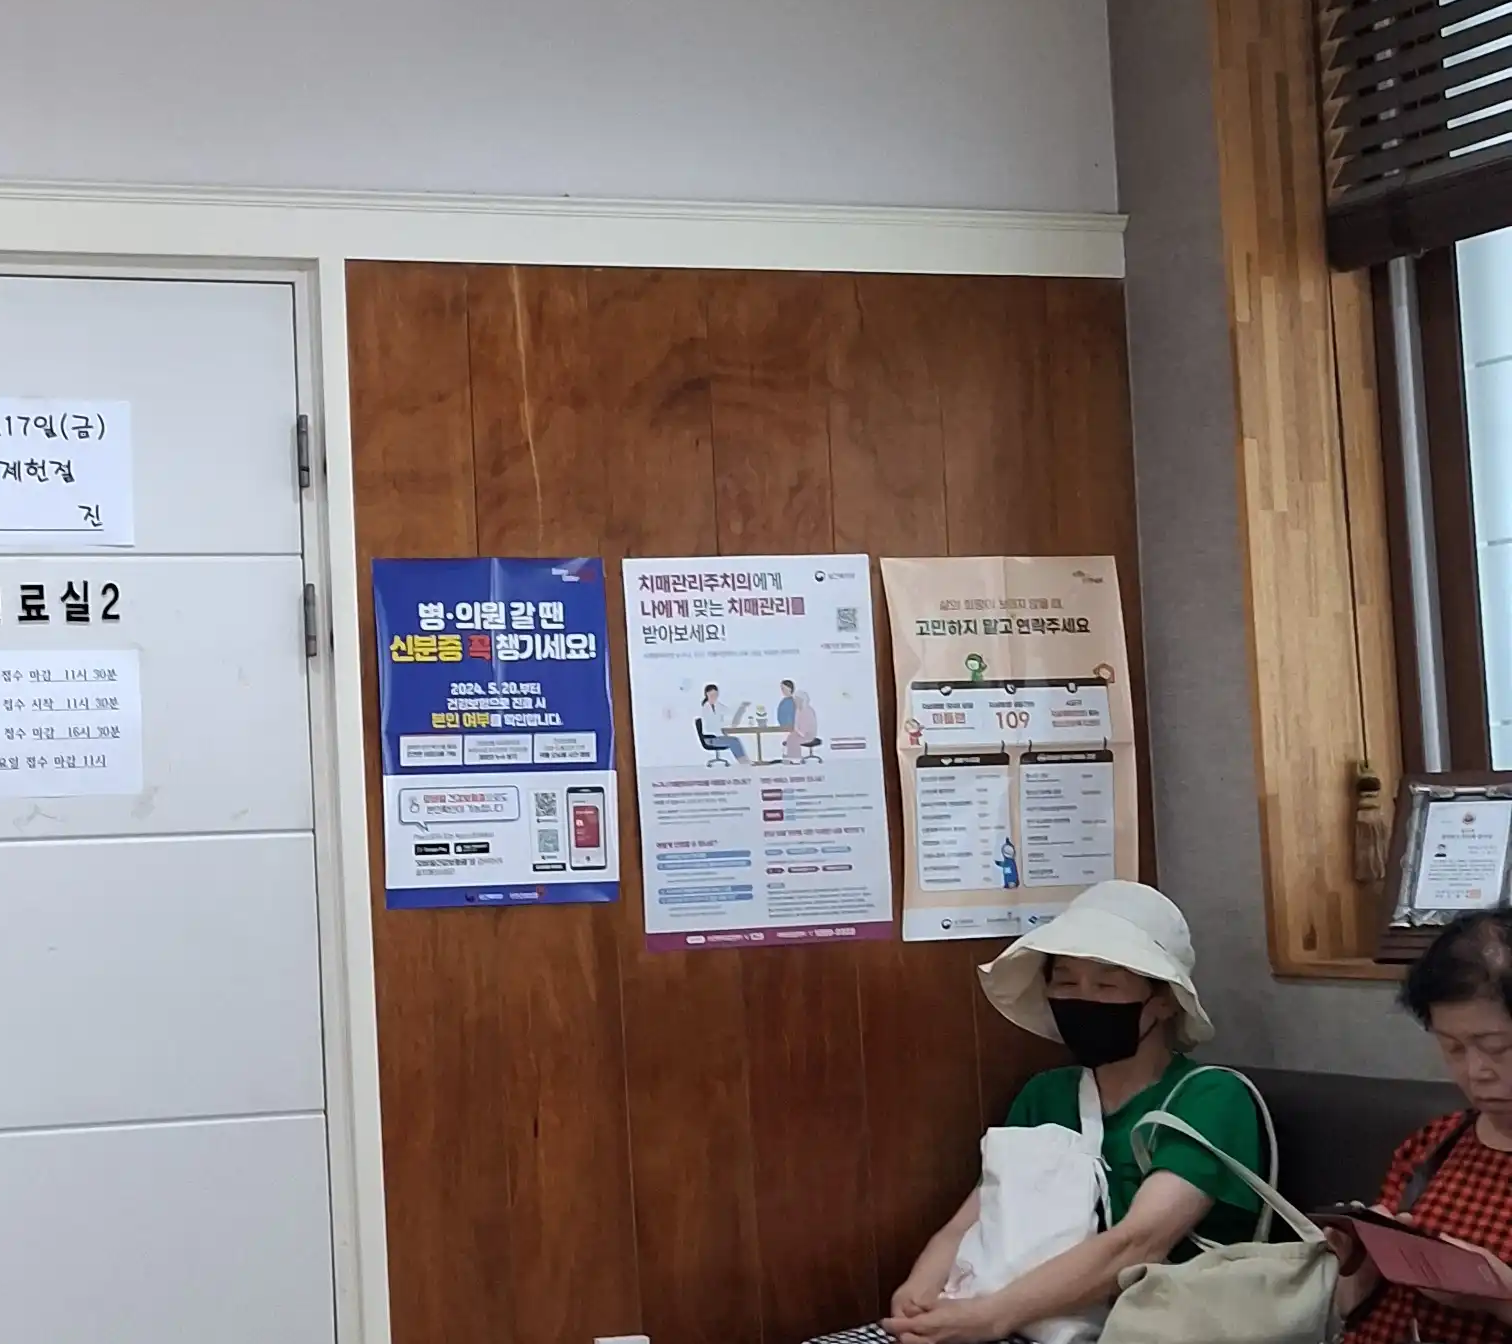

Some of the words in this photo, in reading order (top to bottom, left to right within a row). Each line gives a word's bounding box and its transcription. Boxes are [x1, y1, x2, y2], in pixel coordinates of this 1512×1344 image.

[78, 504, 103, 527] 진
[638, 570, 782, 593] 치매관리주치의에게
[418, 601, 507, 631] 병·의원
[510, 601, 536, 630] 갈
[540, 601, 565, 630] 땐
[640, 598, 690, 619] 나에게
[693, 599, 724, 618] 맞는
[728, 596, 805, 617] 치매관리를
[642, 624, 726, 645] 받아보세요!
[916, 618, 977, 636] 고민하지
[983, 618, 1013, 635] 말고
[1017, 616, 1090, 635] 연락주세요
[389, 634, 463, 662] 신분증
[495, 633, 596, 661] 챙기세요!
[1, 669, 23, 683] 접수
[3, 698, 25, 711] 접수
[535, 697, 546, 709] 시
[432, 713, 460, 729] 본인
[462, 712, 502, 728] 여부를
[995, 711, 1030, 731] 109
[5, 727, 26, 740] 접수
[26, 756, 48, 769] 접수
